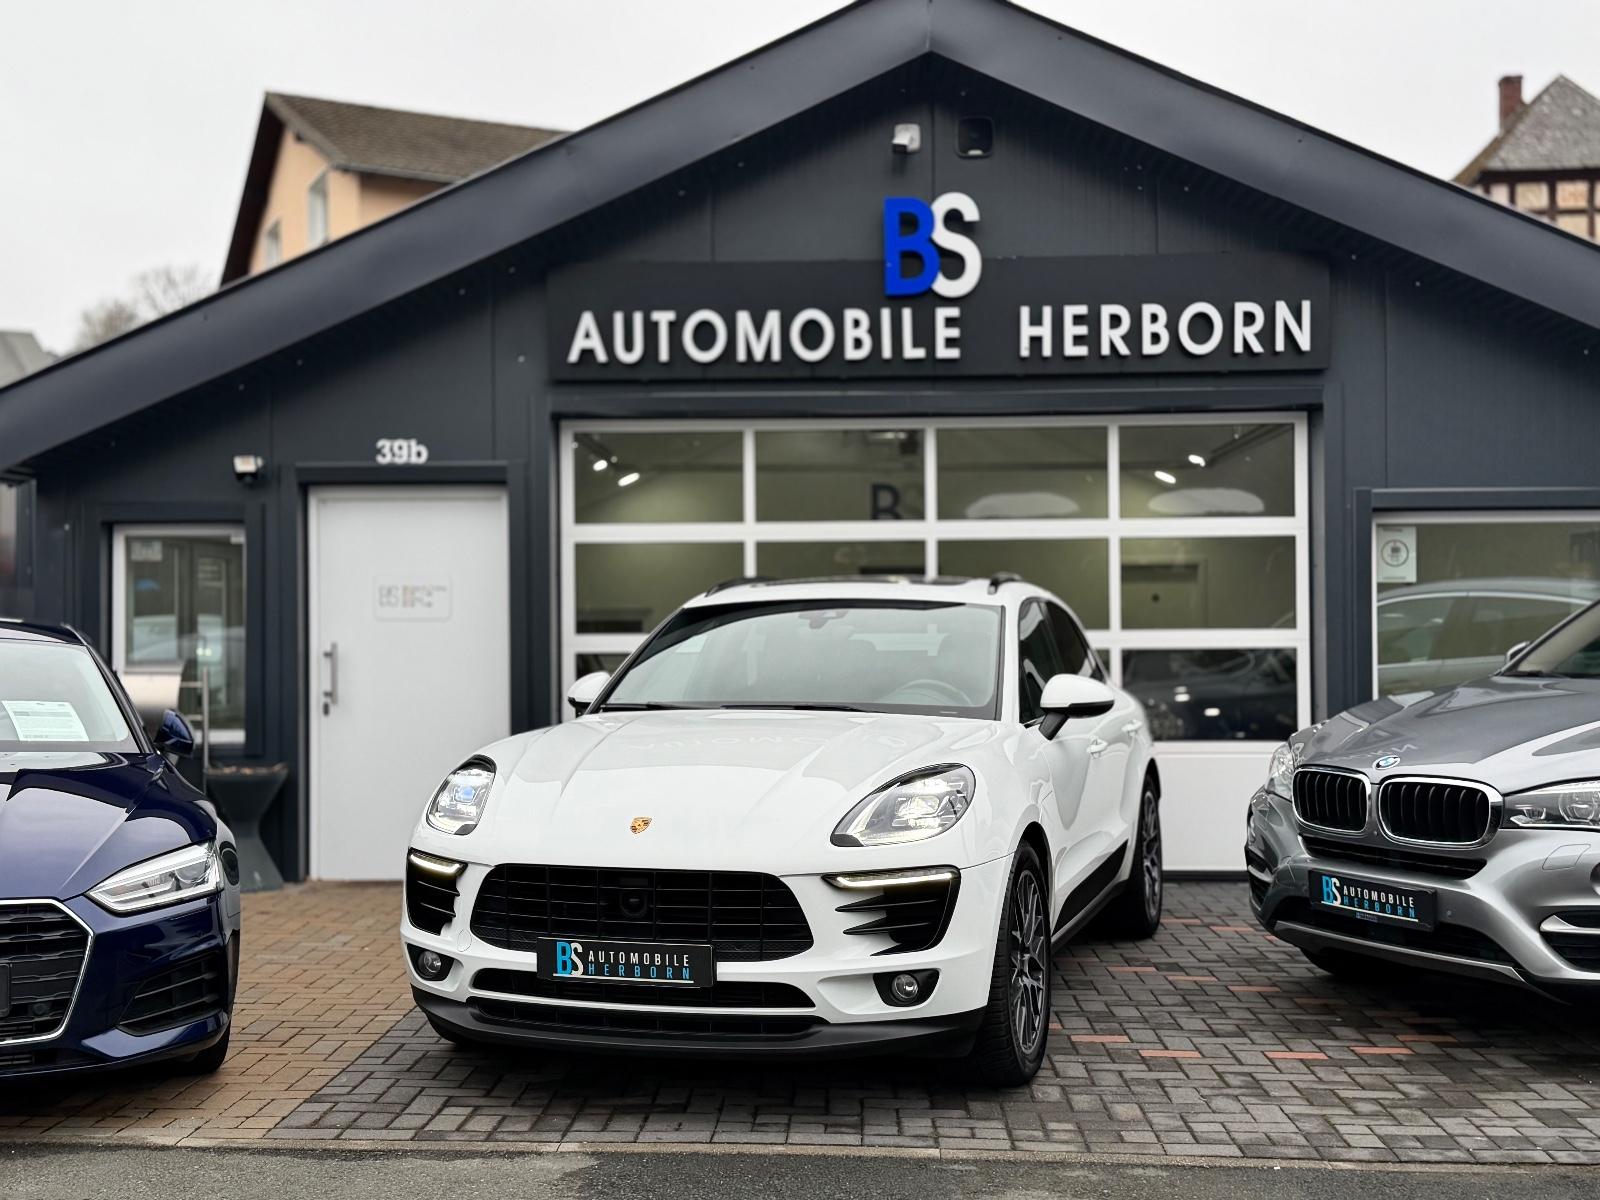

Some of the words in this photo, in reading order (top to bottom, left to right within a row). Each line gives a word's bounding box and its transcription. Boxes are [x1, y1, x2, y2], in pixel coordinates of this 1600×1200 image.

[883, 191, 982, 299] BS
[567, 307, 962, 364] AUTOMOBILE
[1019, 300, 1312, 358] HERBORN
[375, 438, 429, 465] 39b
[1322, 875, 1342, 906] BS
[1343, 885, 1415, 908] AUTOMOBILE
[1343, 896, 1416, 918] HERBORN
[556, 941, 584, 977] BS
[588, 950, 690, 967] AUTOMOBILE
[588, 963, 691, 980] HERBORN
